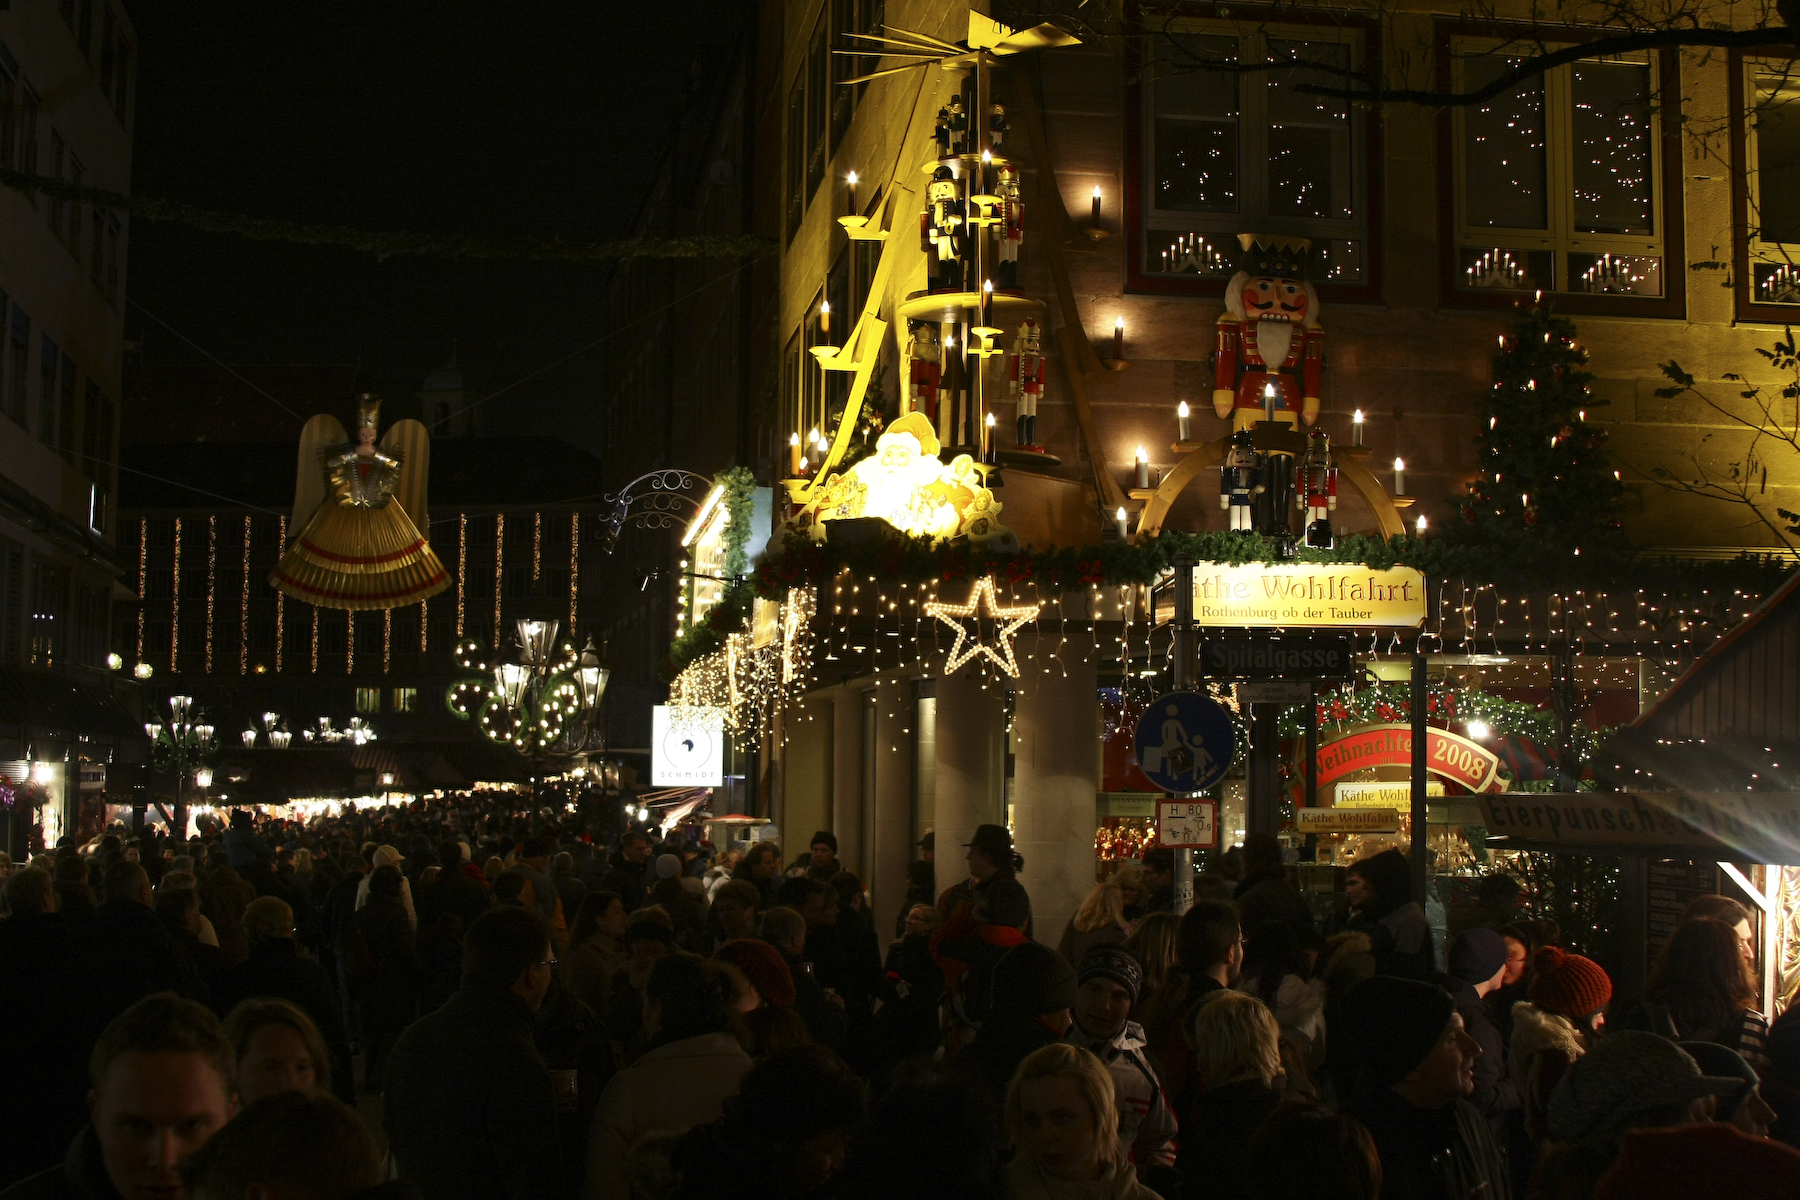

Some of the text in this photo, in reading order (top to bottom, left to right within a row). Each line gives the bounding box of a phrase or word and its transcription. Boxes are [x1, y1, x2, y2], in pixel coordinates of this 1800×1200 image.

[1193, 575, 1250, 599] äthe
[1201, 605, 1373, 620] Rothenburg ob der Tauber
[1212, 643, 1339, 673] Spitalgasse
[1316, 732, 1488, 780] Weihnachte 2008
[1341, 789, 1375, 802] Käthe
[1170, 804, 1202, 815] H 80
[1302, 813, 1335, 823] Käthe
[1485, 795, 1656, 838] Eierpunsch
